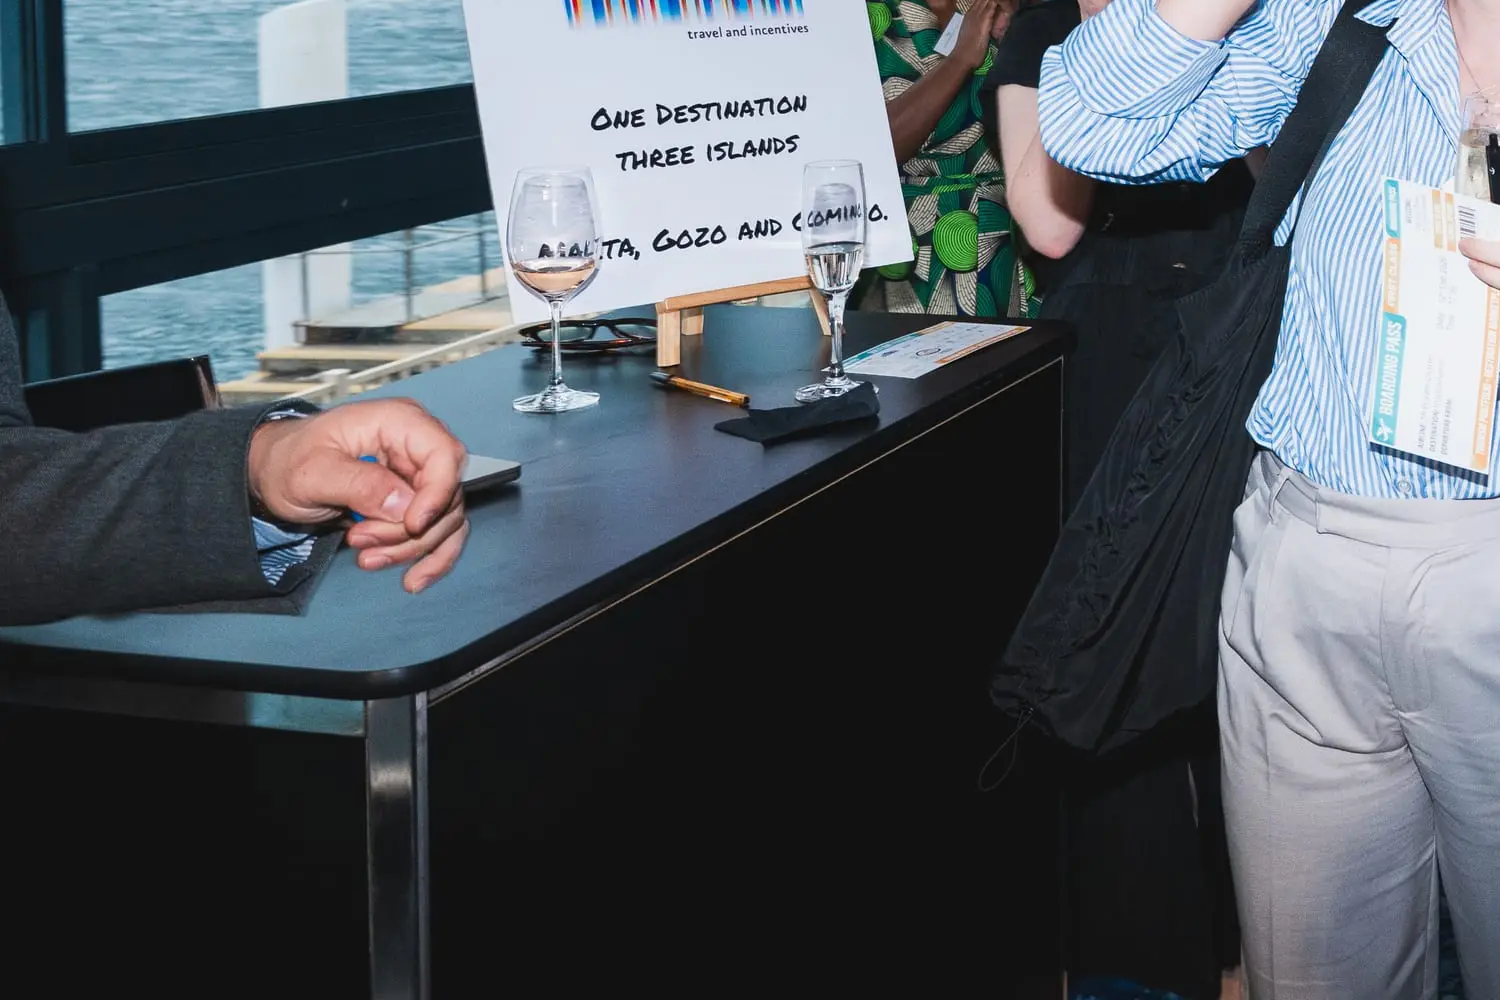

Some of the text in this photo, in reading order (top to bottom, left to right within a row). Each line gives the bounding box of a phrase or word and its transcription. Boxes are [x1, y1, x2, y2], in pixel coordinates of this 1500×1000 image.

[687, 23, 809, 40] travel and incentives
[615, 134, 800, 172] THREE ISLANDS
[738, 218, 783, 241] AND
[1378, 319, 1402, 416] BOARDING PASS
